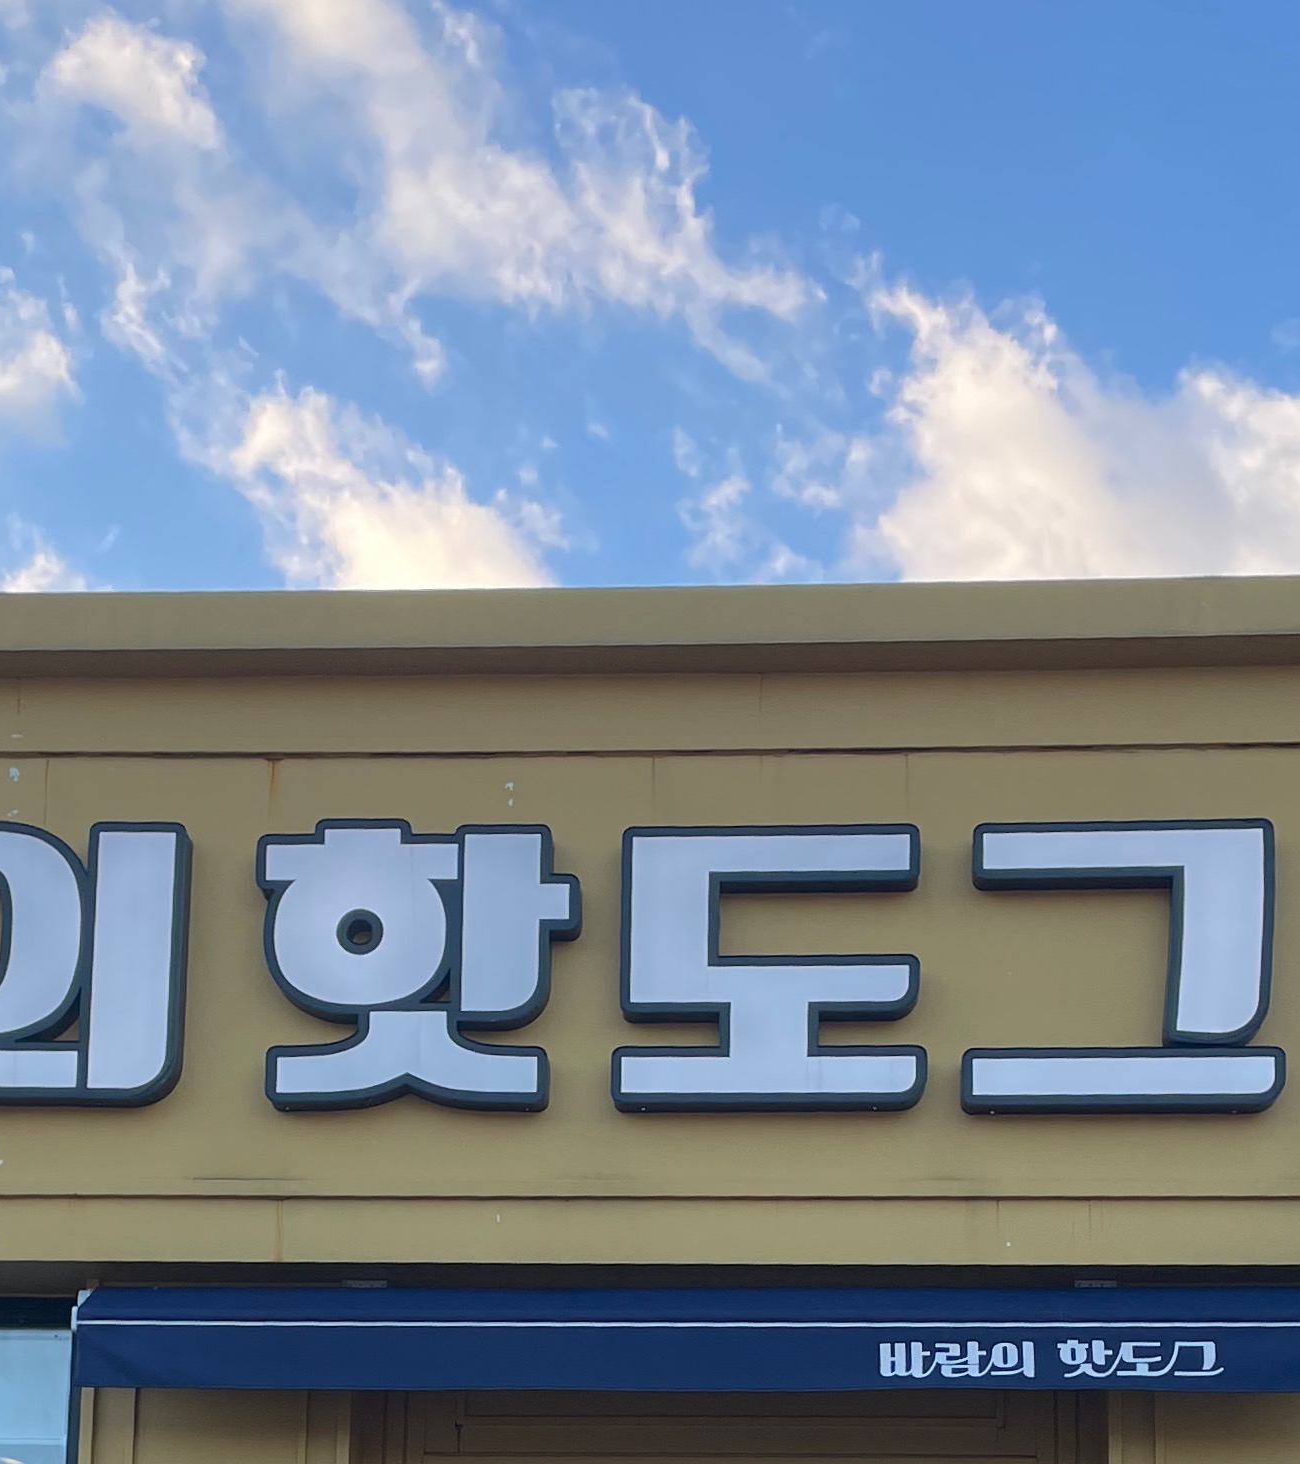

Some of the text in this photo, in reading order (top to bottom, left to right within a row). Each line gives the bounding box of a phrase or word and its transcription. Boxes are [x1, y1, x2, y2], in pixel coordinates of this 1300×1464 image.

[257, 819, 1285, 1115] 핫도그
[878, 1338, 1225, 1379] 바람의 핫도그
